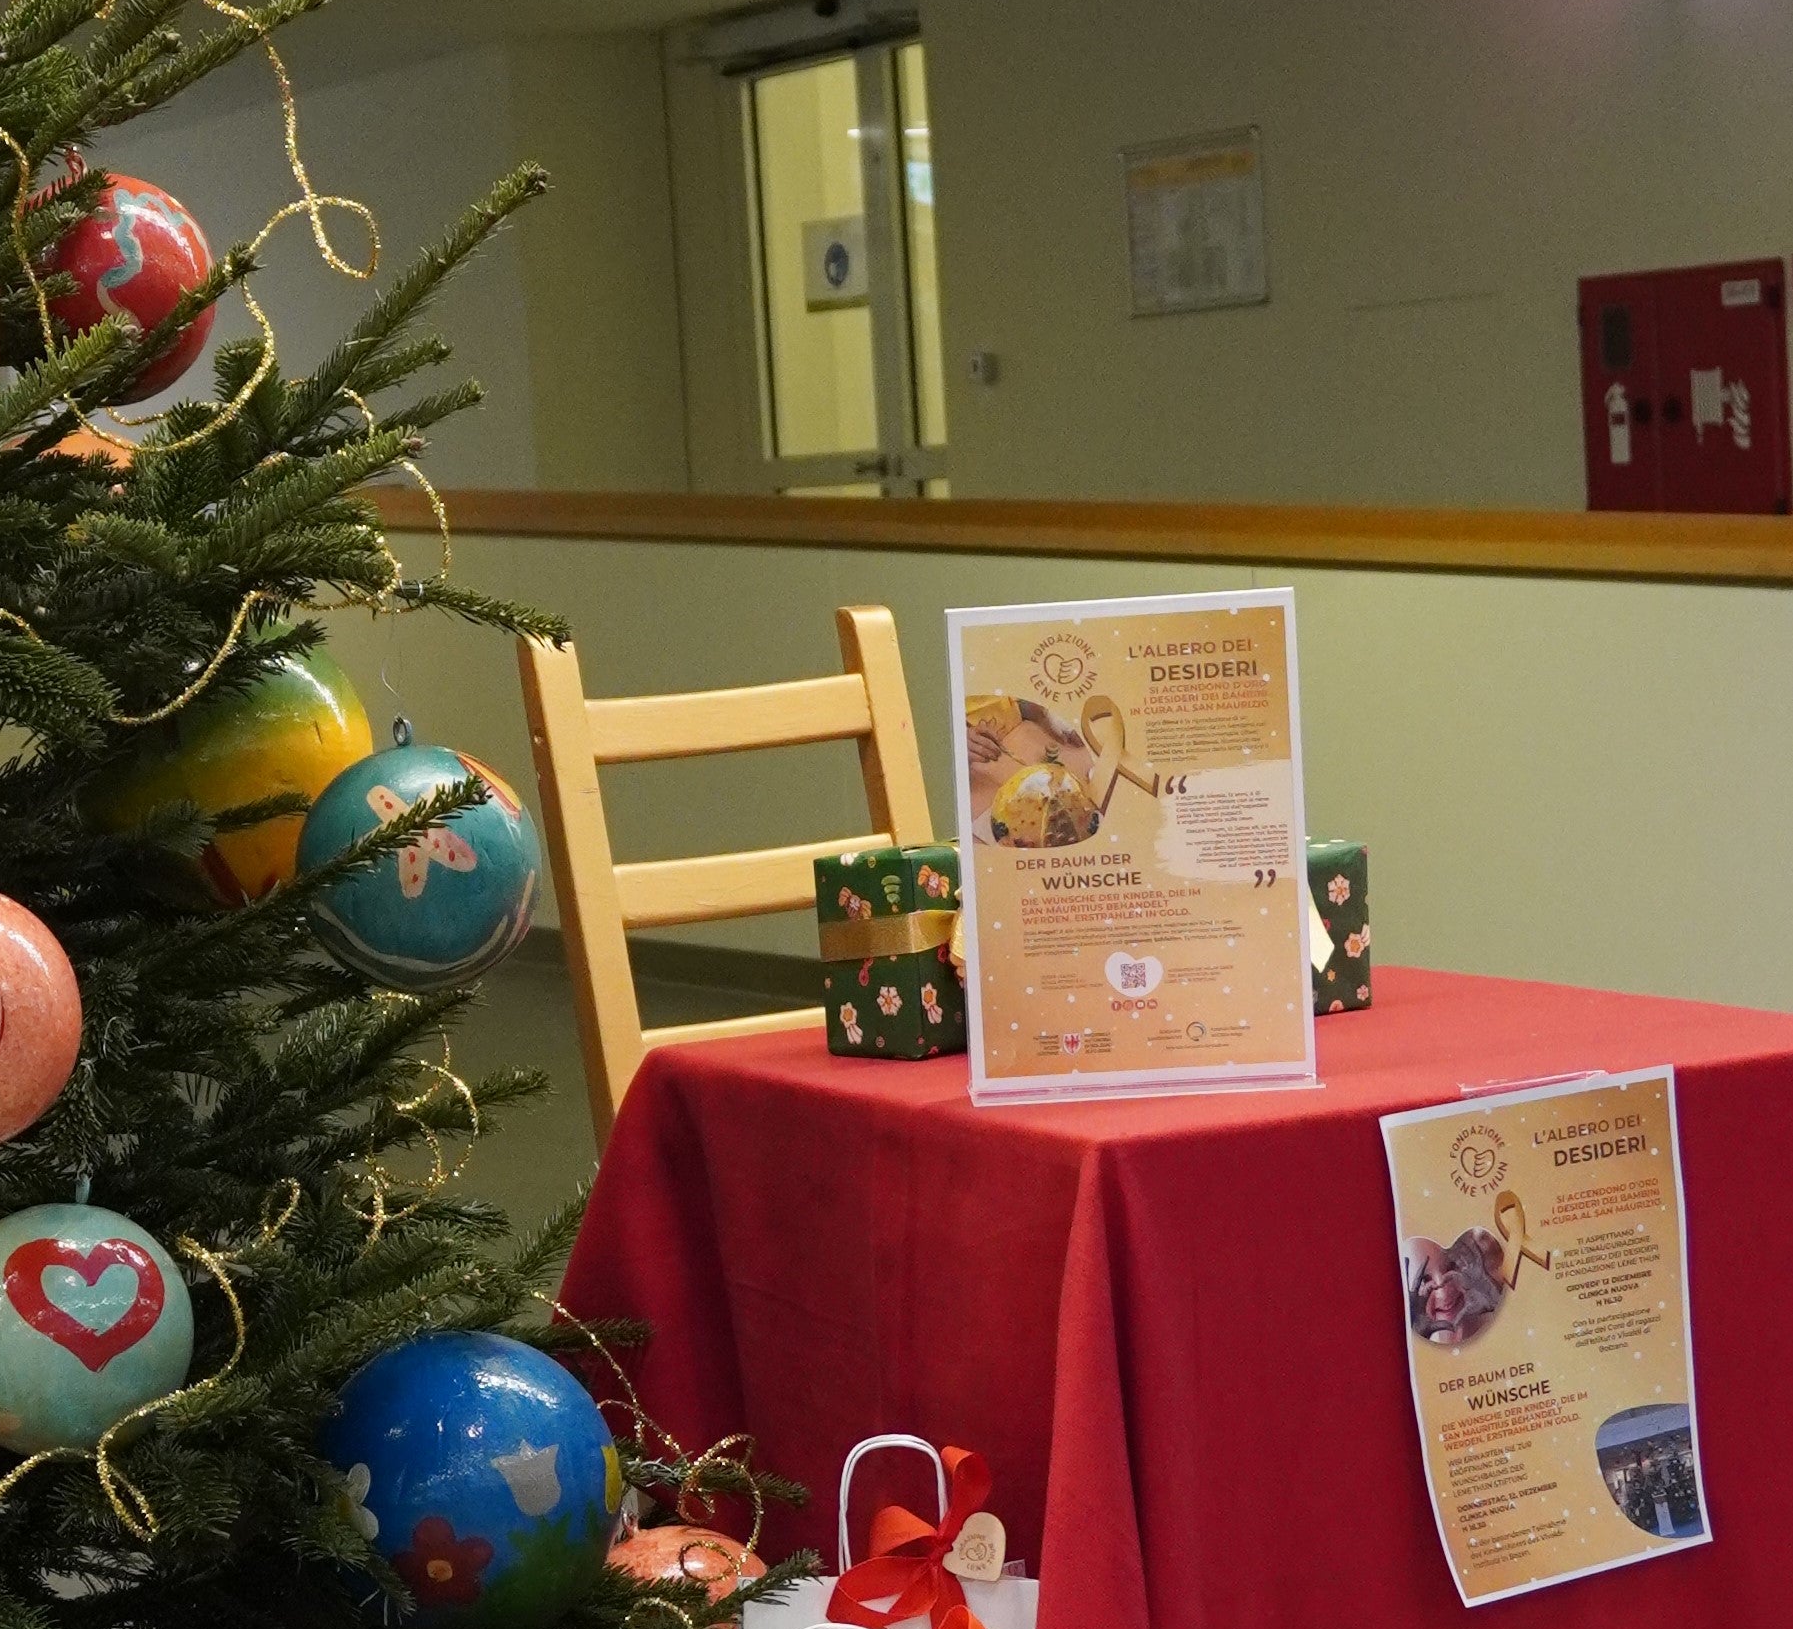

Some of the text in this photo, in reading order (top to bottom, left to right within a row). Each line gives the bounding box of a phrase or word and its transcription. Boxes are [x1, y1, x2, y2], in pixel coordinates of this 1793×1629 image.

[1031, 634, 1096, 663] FONDAZIONE
[1129, 639, 1252, 659] L'ALBERO DEI
[1150, 660, 1258, 682] DESIDERI
[1030, 671, 1098, 702] LENE THUN
[1143, 705, 1175, 715] CURA
[1192, 702, 1213, 712] SAN
[1016, 853, 1131, 870] DER BAUM DER
[1041, 871, 1142, 891] WÜNSCHE
[1450, 1125, 1505, 1159] FONDAZIONE
[1534, 1114, 1640, 1145] L'ALBERO DEI
[1554, 1135, 1646, 1167] DESIDERI
[1450, 1162, 1508, 1197] LENE THUN
[1552, 1213, 1578, 1225] CURA
[1594, 1208, 1613, 1217] SAN
[1439, 1362, 1534, 1394] DER BAUM DER
[1468, 1380, 1551, 1411] WÜNSCHE
[1561, 1395, 1576, 1404] DIE
